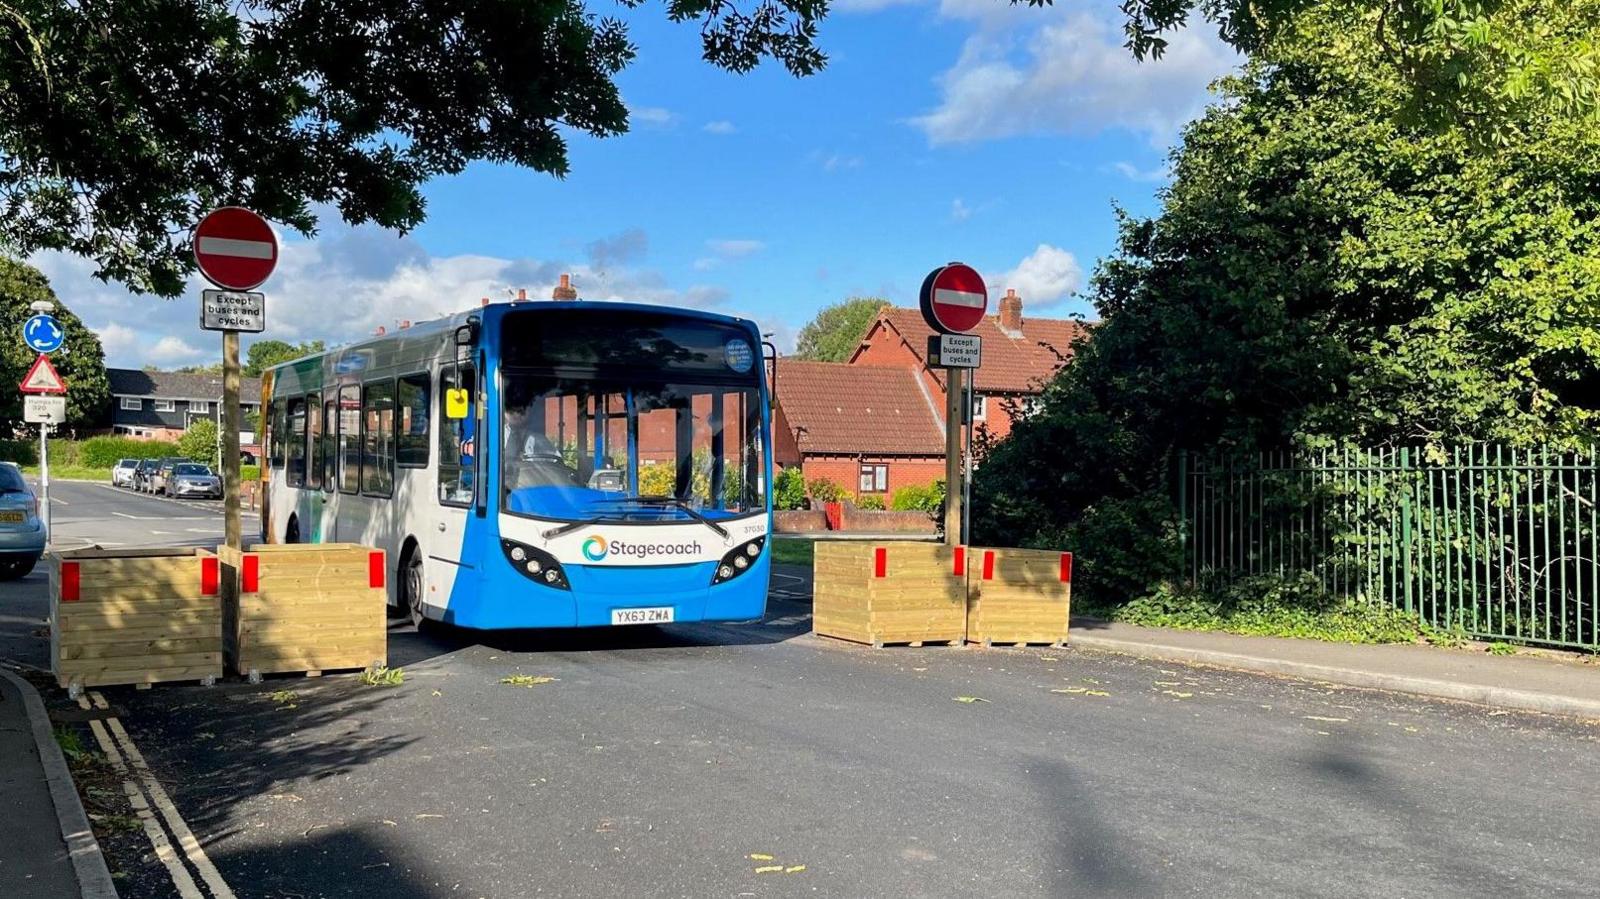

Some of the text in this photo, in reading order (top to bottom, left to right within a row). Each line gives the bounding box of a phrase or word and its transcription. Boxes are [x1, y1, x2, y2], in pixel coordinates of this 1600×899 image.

[216, 295, 252, 306] Except
[208, 305, 260, 316] buses and
[218, 317, 251, 326] cycles
[949, 338, 973, 346] Except
[943, 346, 978, 356] buses and
[949, 356, 971, 364] cycles
[609, 540, 702, 558] Stagecoach
[616, 609, 670, 622] YX63 ZWA
